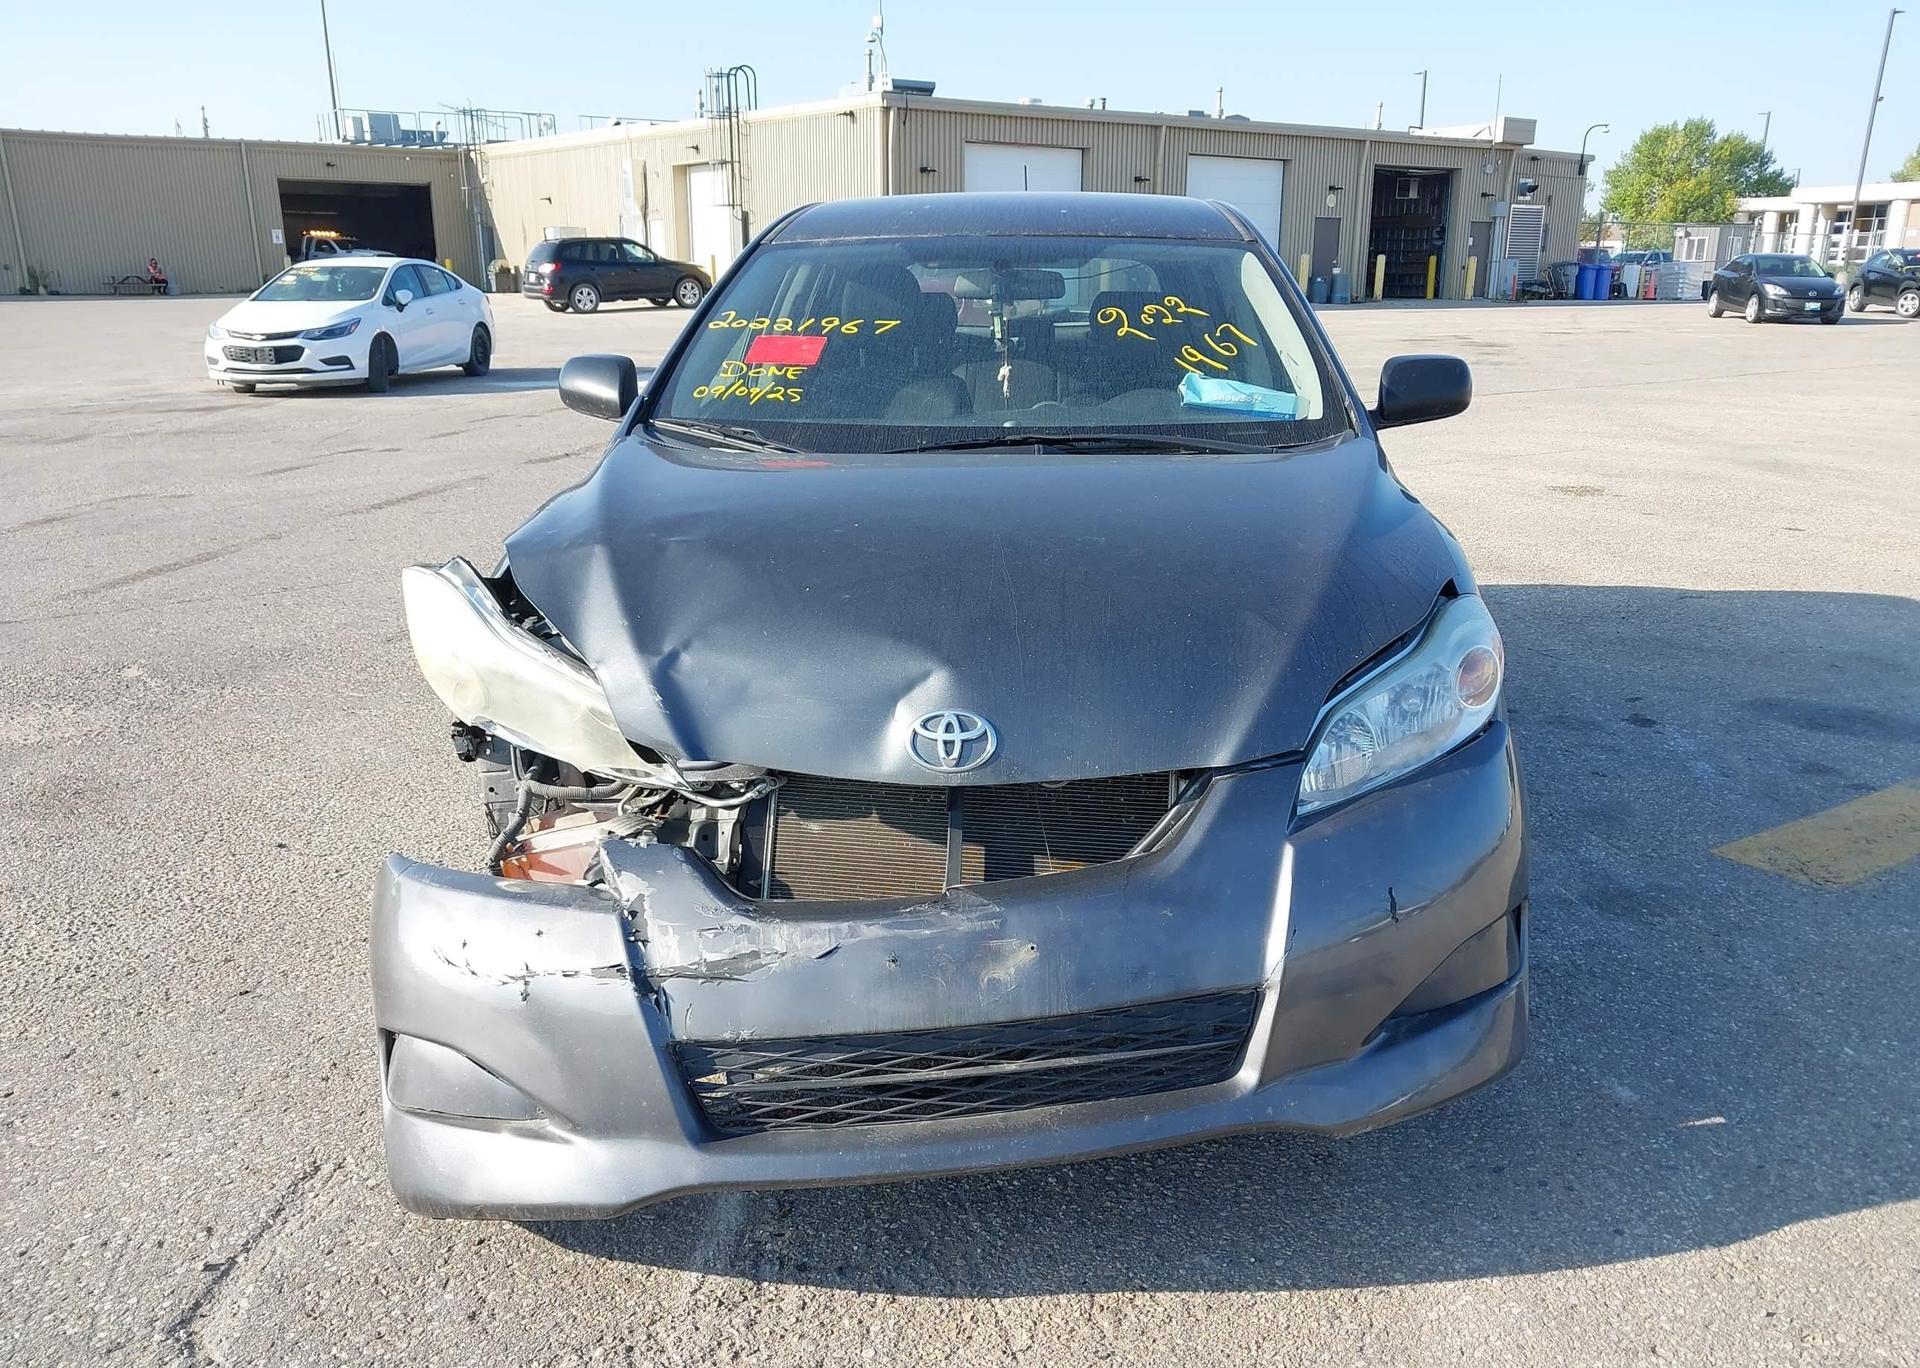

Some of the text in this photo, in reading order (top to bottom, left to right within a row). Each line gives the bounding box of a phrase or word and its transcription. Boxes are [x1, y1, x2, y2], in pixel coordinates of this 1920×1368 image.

[1096, 295, 1211, 341] 2022
[1173, 323, 1259, 376] 1967
[720, 360, 808, 380] DONE
[692, 378, 805, 406] 09/09/25
